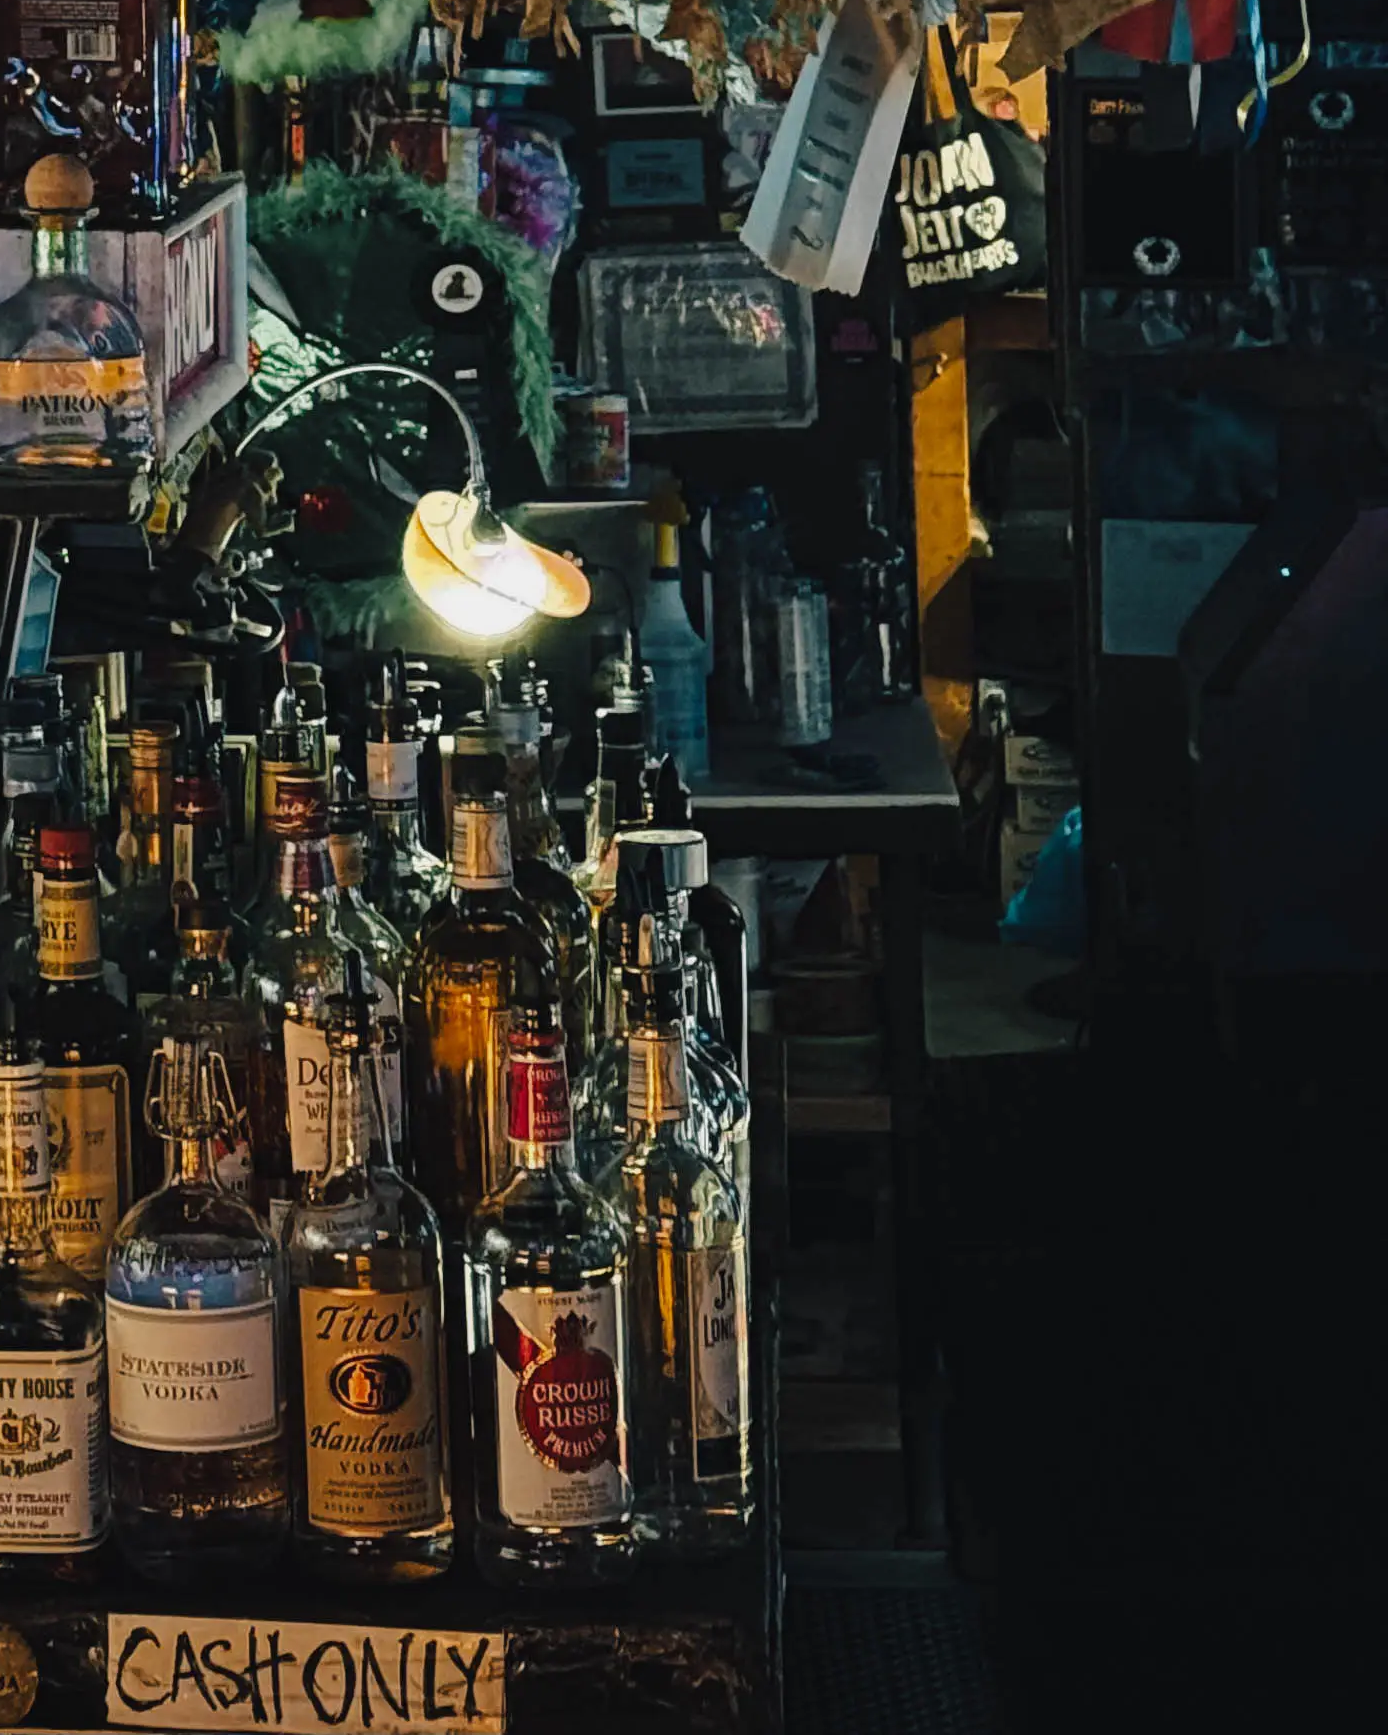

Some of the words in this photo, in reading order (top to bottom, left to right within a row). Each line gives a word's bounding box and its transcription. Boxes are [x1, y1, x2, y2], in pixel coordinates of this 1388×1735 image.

[895, 132, 994, 207] JOAN
[899, 205, 964, 259] JETT
[316, 1301, 422, 1343] Tito's
[120, 1353, 247, 1378] STATESIDE
[23, 1377, 75, 1399] HOUSE
[142, 1383, 219, 1401] VODKA
[539, 1402, 610, 1429] RUSSE
[543, 1427, 608, 1458] PREMIUM
[339, 1460, 411, 1476] VODKA
[115, 1626, 297, 1725] CASH
[302, 1633, 490, 1728] ONLY
